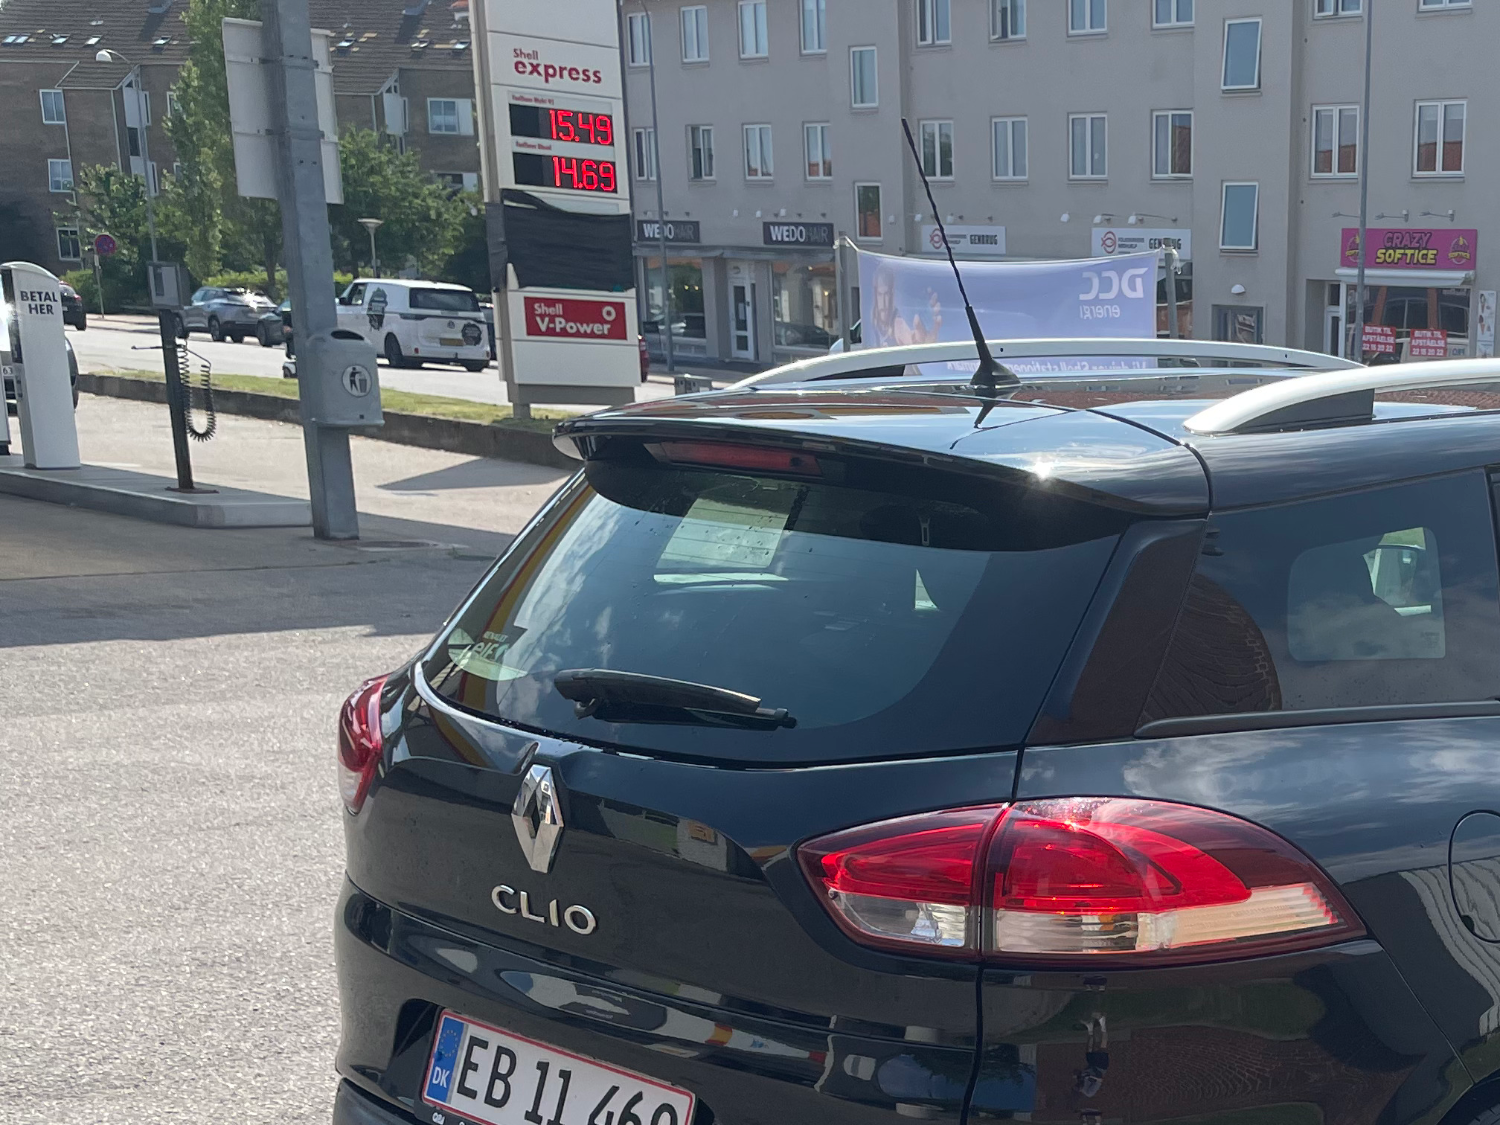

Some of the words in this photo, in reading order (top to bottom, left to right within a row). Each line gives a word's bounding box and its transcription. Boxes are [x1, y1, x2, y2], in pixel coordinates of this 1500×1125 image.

[513, 48, 539, 60] Shell
[514, 60, 602, 84] express
[549, 109, 612, 145] 15.49
[553, 155, 615, 191] 14.69
[1384, 232, 1431, 247] CRAZY
[1376, 249, 1437, 264] SOFTICE
[20, 290, 58, 302] BETAL
[28, 303, 54, 315] HER
[534, 303, 563, 315] Shell
[535, 316, 611, 335] V-Power
[491, 884, 597, 935] CLIO
[432, 1066, 450, 1089] DK
[457, 1035, 517, 1108] EB
